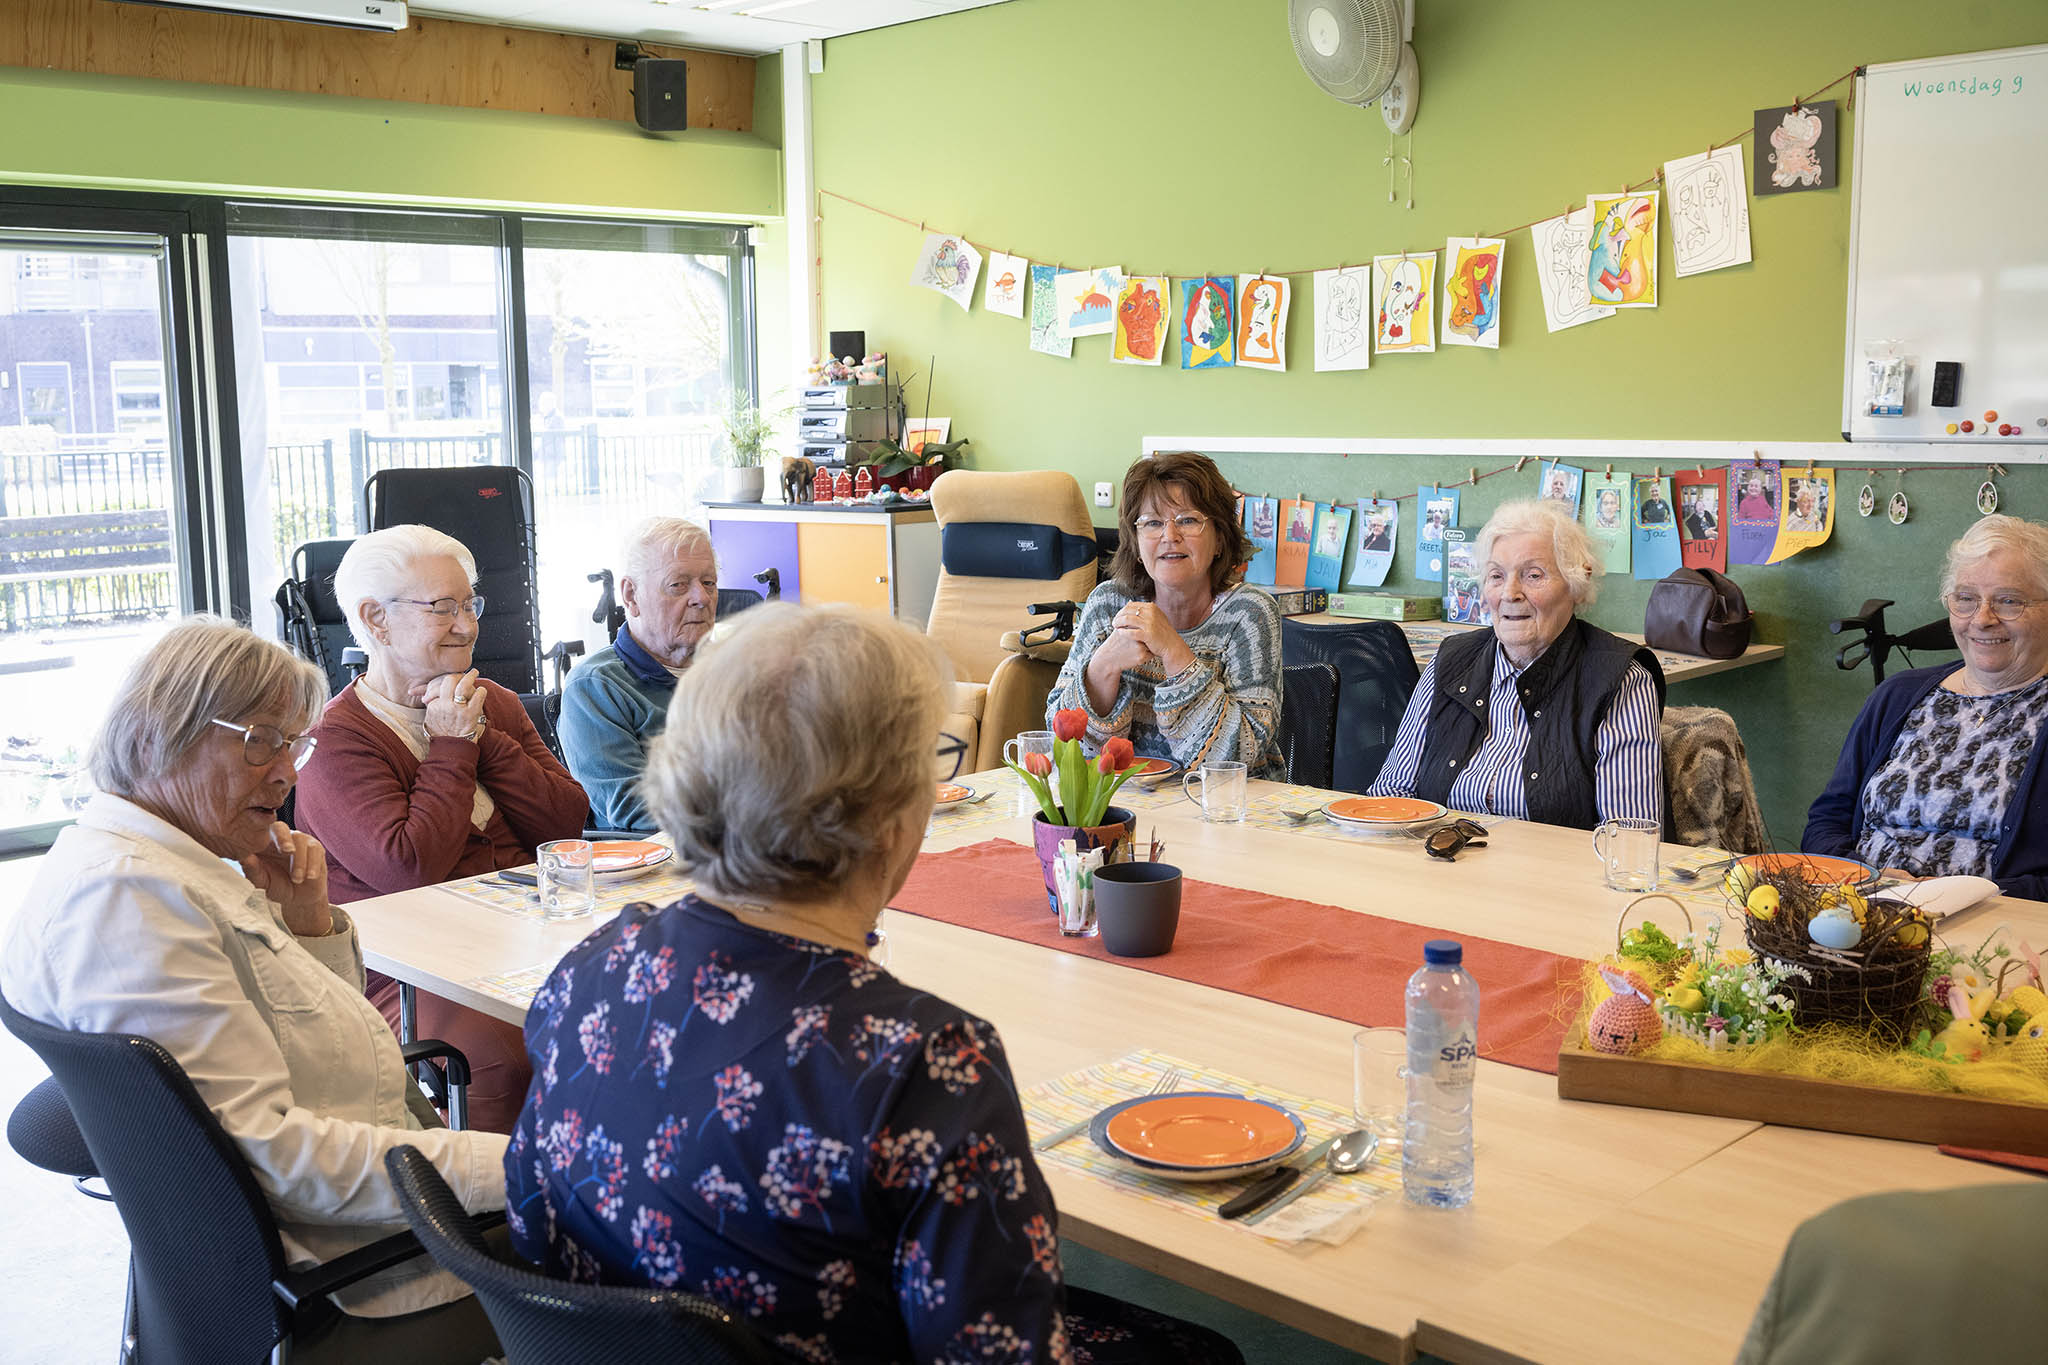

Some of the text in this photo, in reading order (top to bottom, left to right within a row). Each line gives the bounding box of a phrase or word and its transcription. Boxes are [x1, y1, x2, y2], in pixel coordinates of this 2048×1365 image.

[1904, 77, 2003, 97] Woensdag
[1643, 530, 1667, 542] Jac
[1684, 541, 1718, 560] TILLY
[1440, 1044, 1476, 1062] SPA
